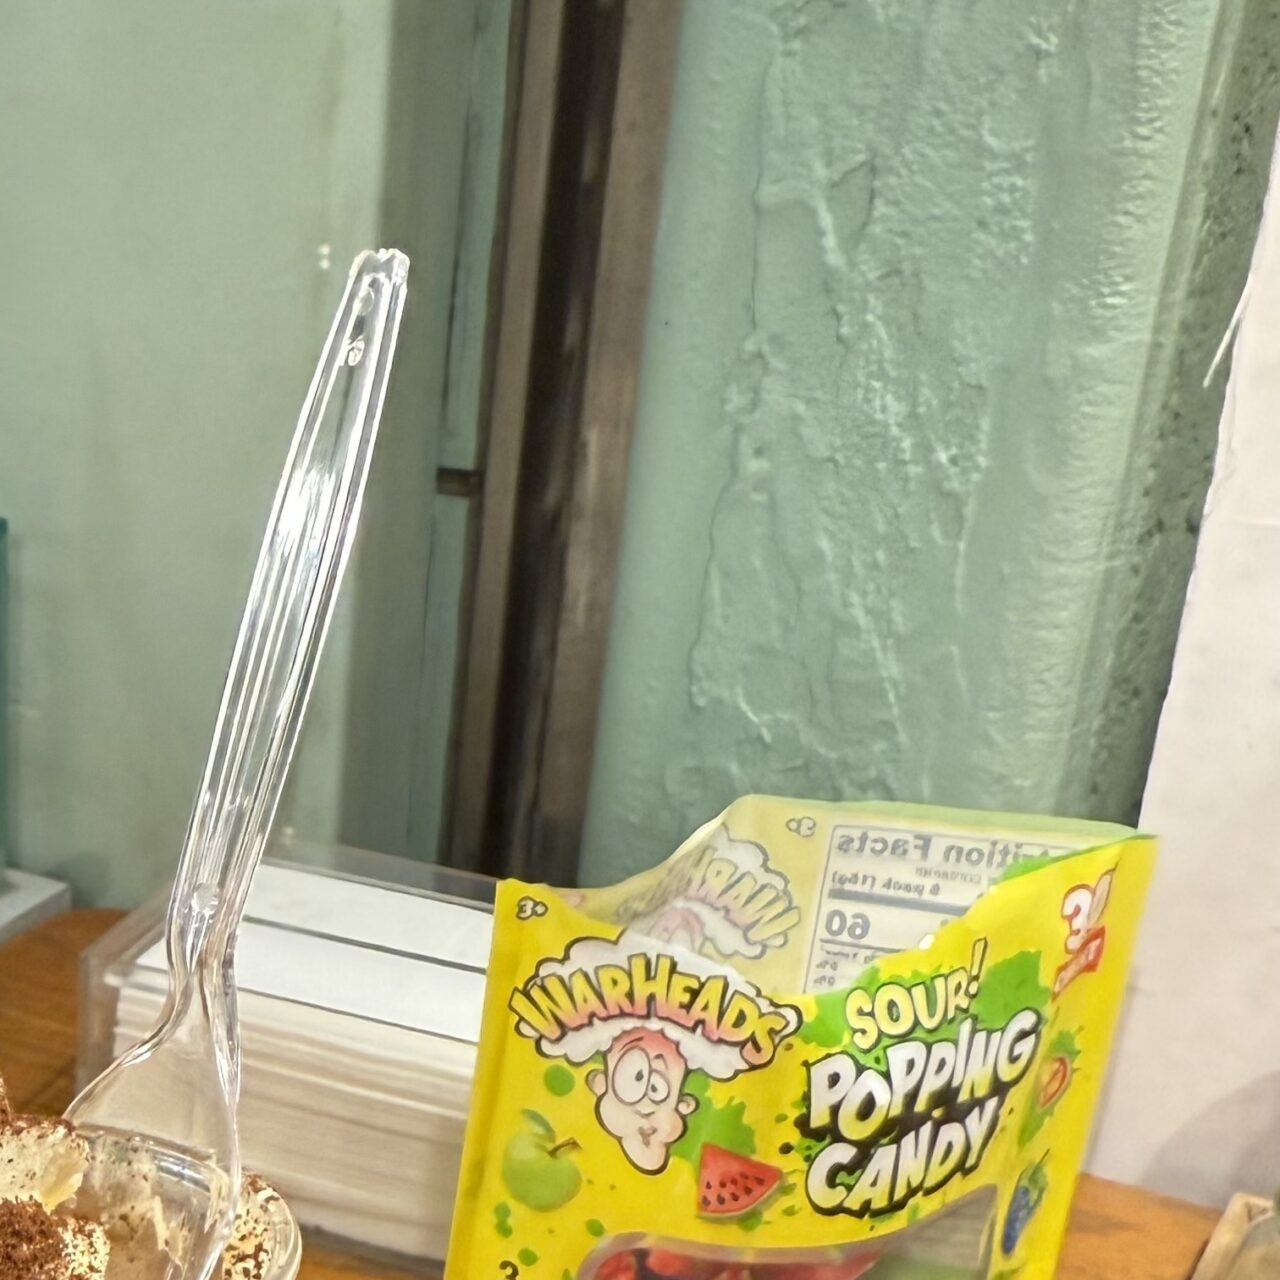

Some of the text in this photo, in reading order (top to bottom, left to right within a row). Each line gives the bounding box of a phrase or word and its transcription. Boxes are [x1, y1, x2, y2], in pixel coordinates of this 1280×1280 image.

[508, 953, 790, 1067] WARHEADS
[845, 936, 988, 1051] SOUR!
[807, 1007, 1043, 1142] POPPING
[805, 1096, 1001, 1218] CANDY
